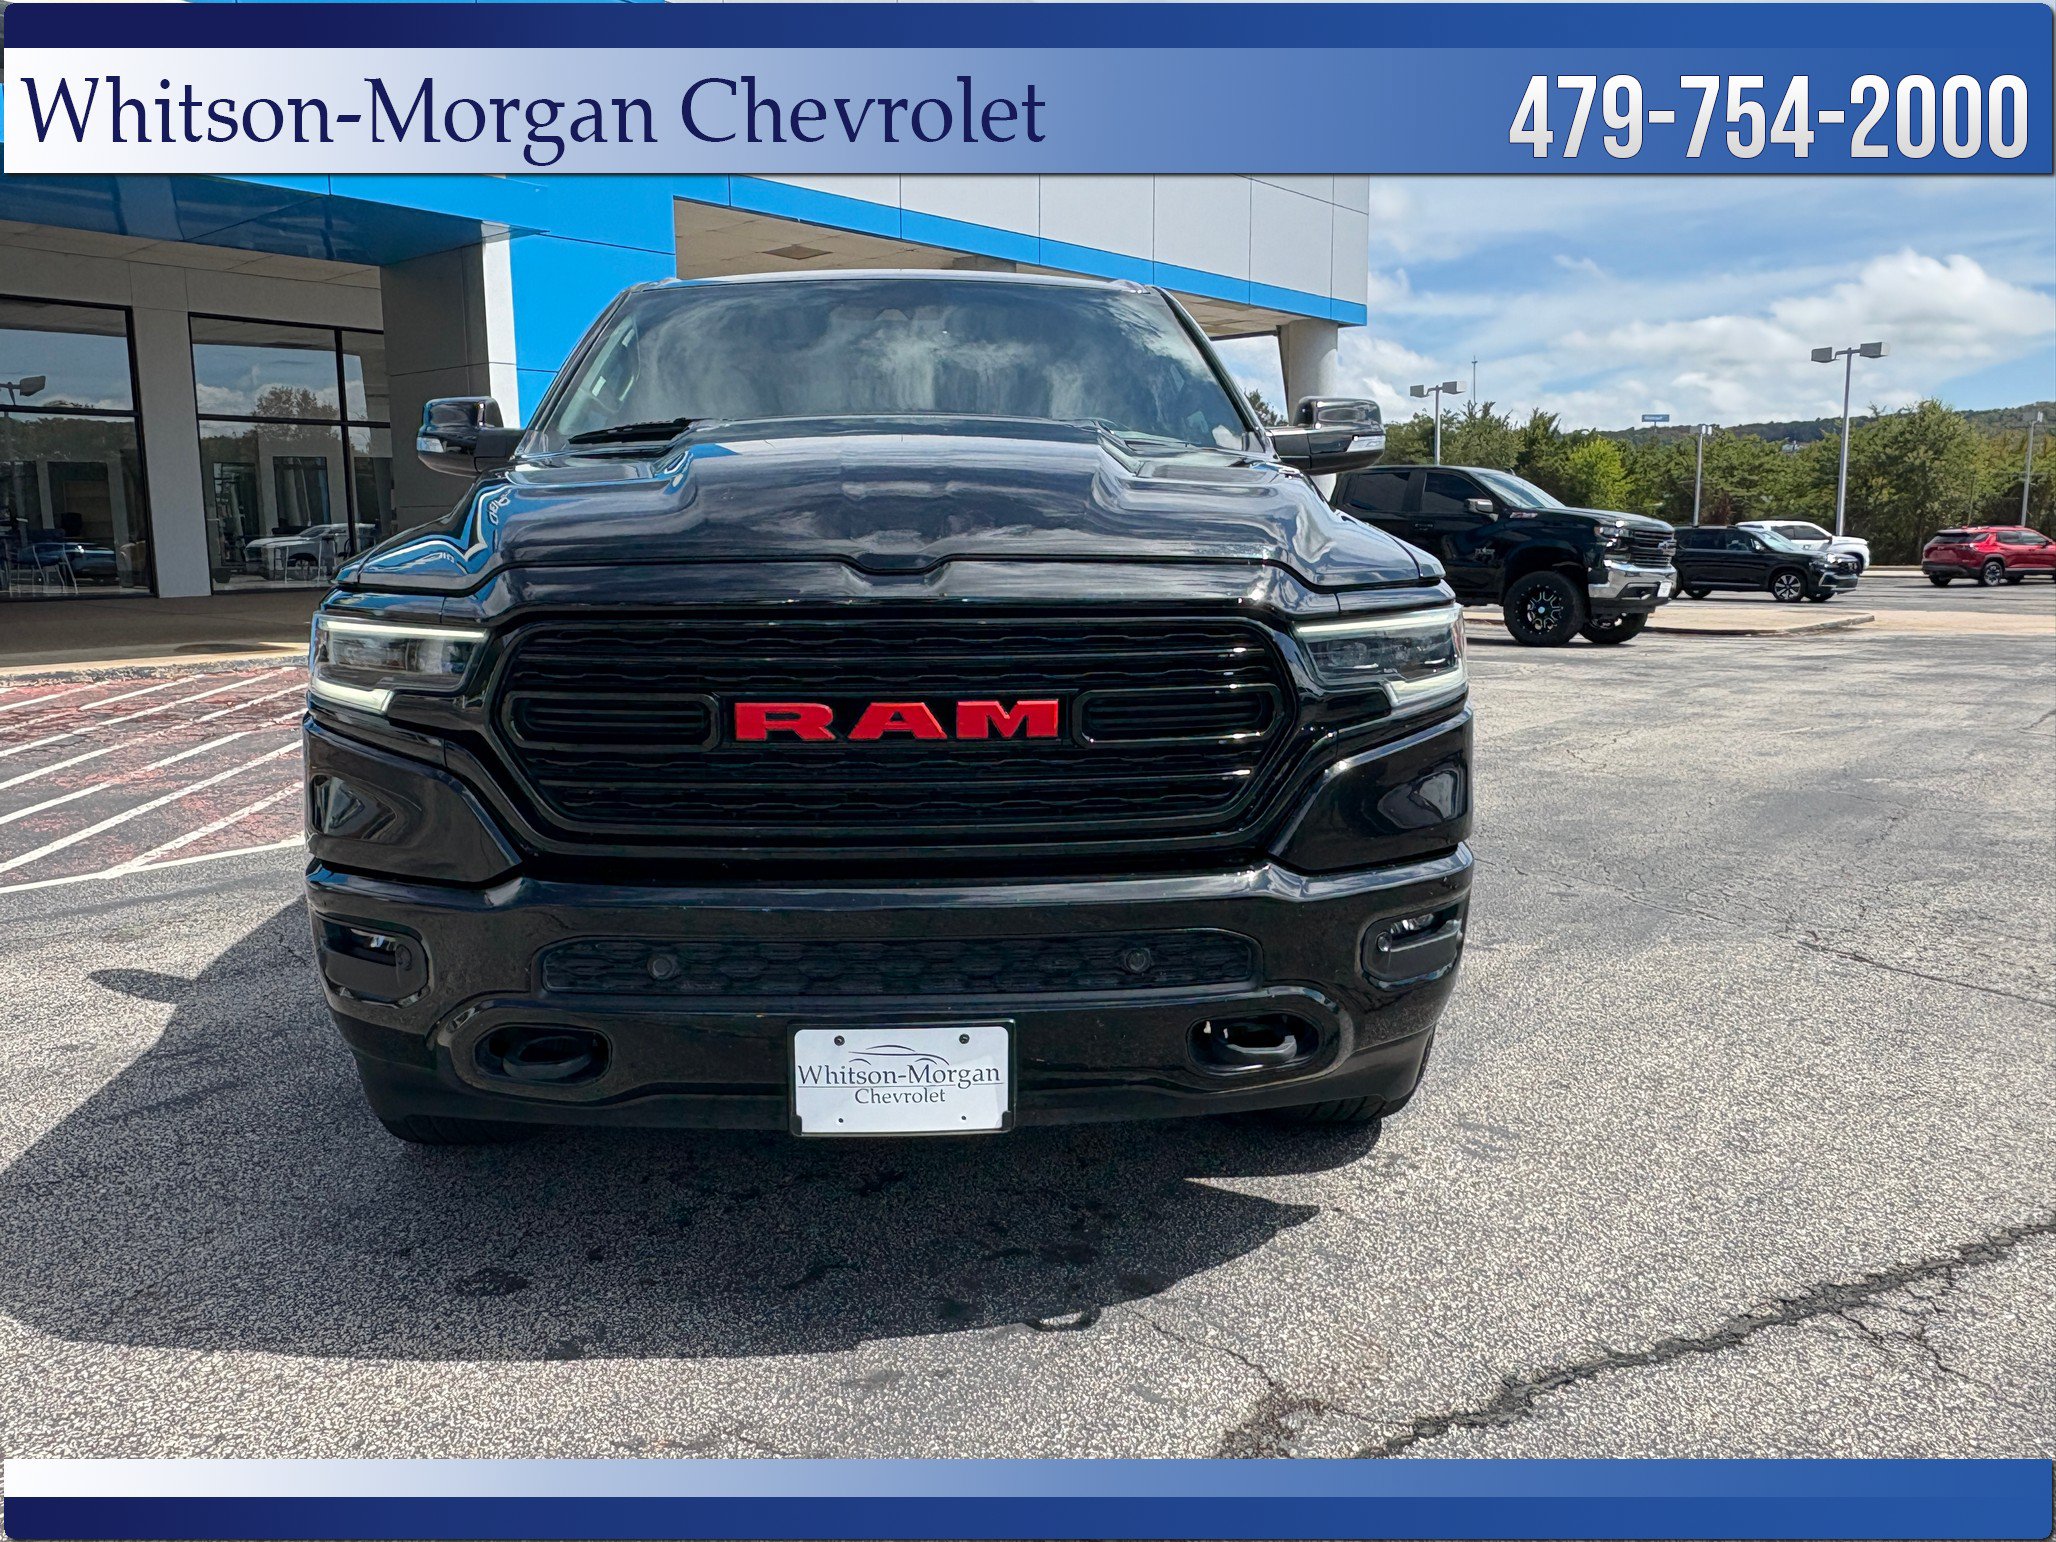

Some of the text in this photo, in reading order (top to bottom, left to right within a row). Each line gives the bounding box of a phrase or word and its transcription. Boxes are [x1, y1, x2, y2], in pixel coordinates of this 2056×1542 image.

[734, 699, 1059, 741] RAM
[797, 1065, 1001, 1089] Whitson-Morgan
[854, 1087, 946, 1105] Chevrolet
